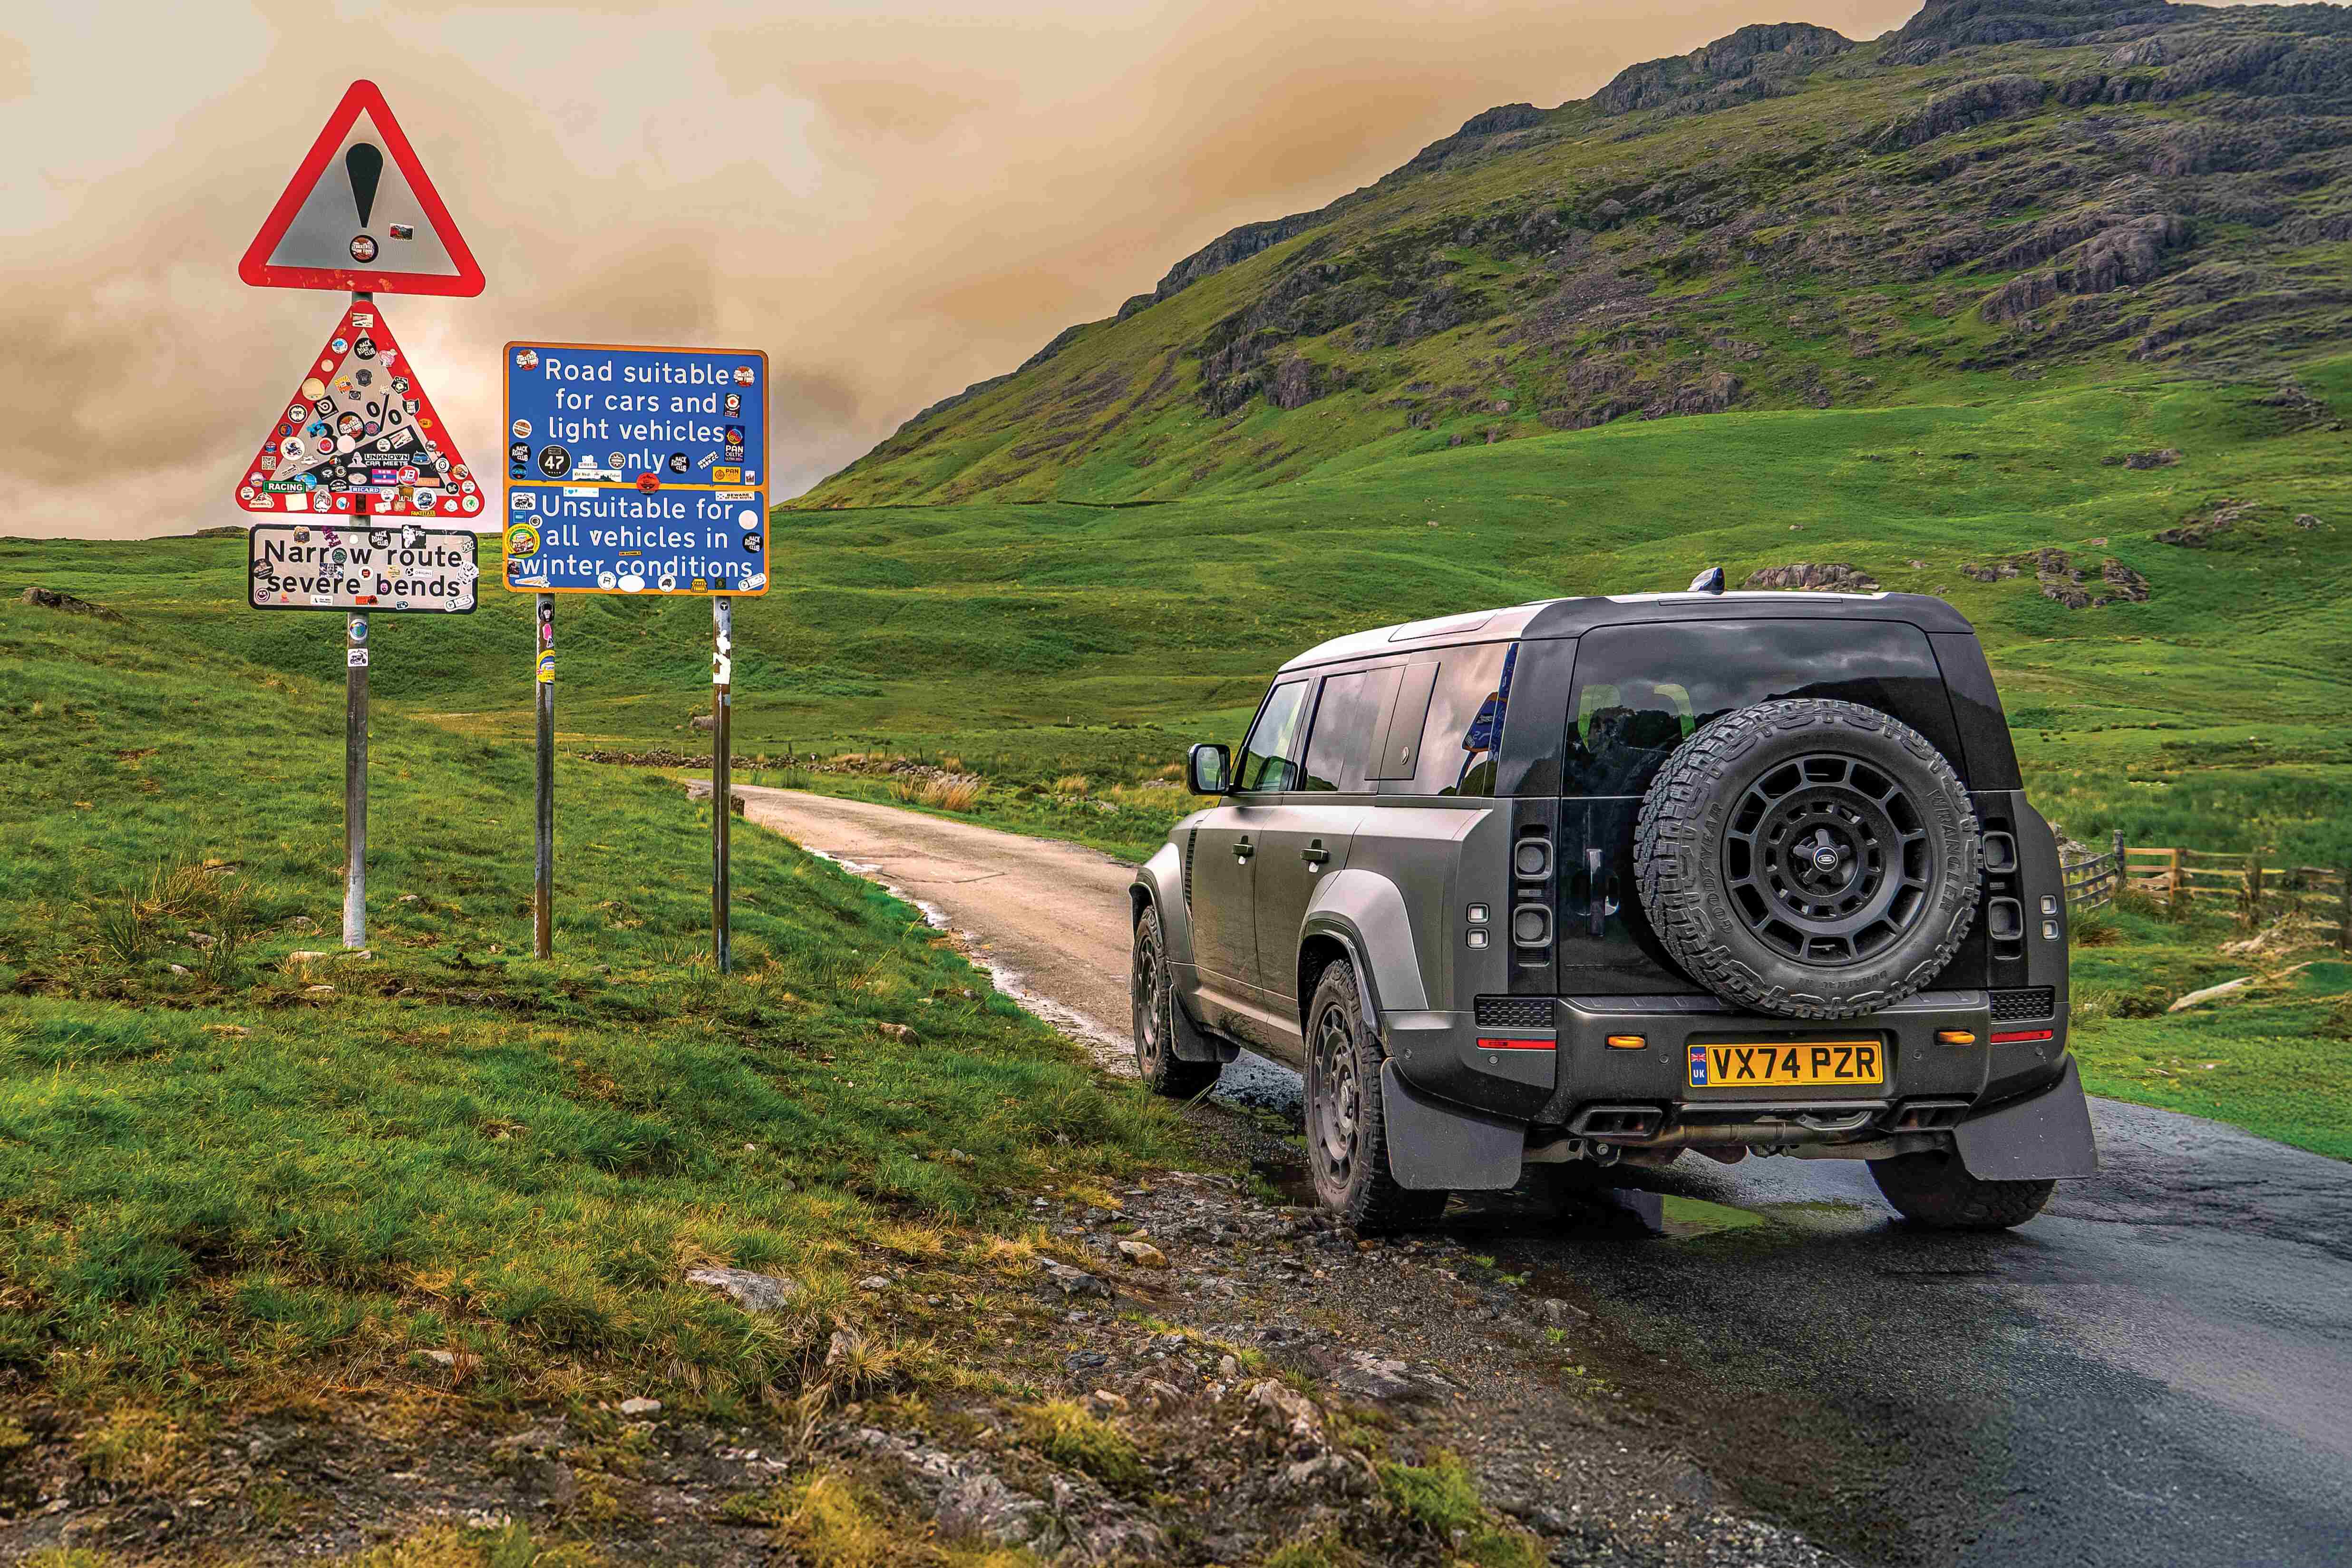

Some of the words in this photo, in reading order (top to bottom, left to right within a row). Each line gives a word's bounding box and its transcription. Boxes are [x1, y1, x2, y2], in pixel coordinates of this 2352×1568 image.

[357, 346, 369, 355] ROAD
[365, 348, 376, 356] CLUB
[546, 358, 612, 381] Road
[624, 362, 729, 385] suitable
[556, 388, 593, 409] for
[605, 395, 660, 411] cars
[671, 392, 716, 413] and
[549, 417, 609, 443] light
[619, 419, 724, 442] vehicles
[628, 448, 665, 474] nly
[726, 445, 743, 453] PAN
[544, 456, 564, 469] 47
[543, 495, 686, 518] Unsuitable
[697, 497, 734, 519] for
[546, 525, 579, 546] all
[590, 526, 695, 548] vehicles
[707, 527, 728, 548] in
[265, 540, 372, 565] Narrw
[387, 545, 462, 567] route
[522, 553, 604, 575] winter
[615, 556, 753, 577] conditions
[267, 575, 360, 594] severe
[377, 573, 460, 597] bends
[1926, 789, 1960, 913] WRANGLER
[1693, 1069, 1705, 1079] UK
[1713, 1047, 1800, 1079] VX74
[1811, 1047, 1876, 1078] PZR
